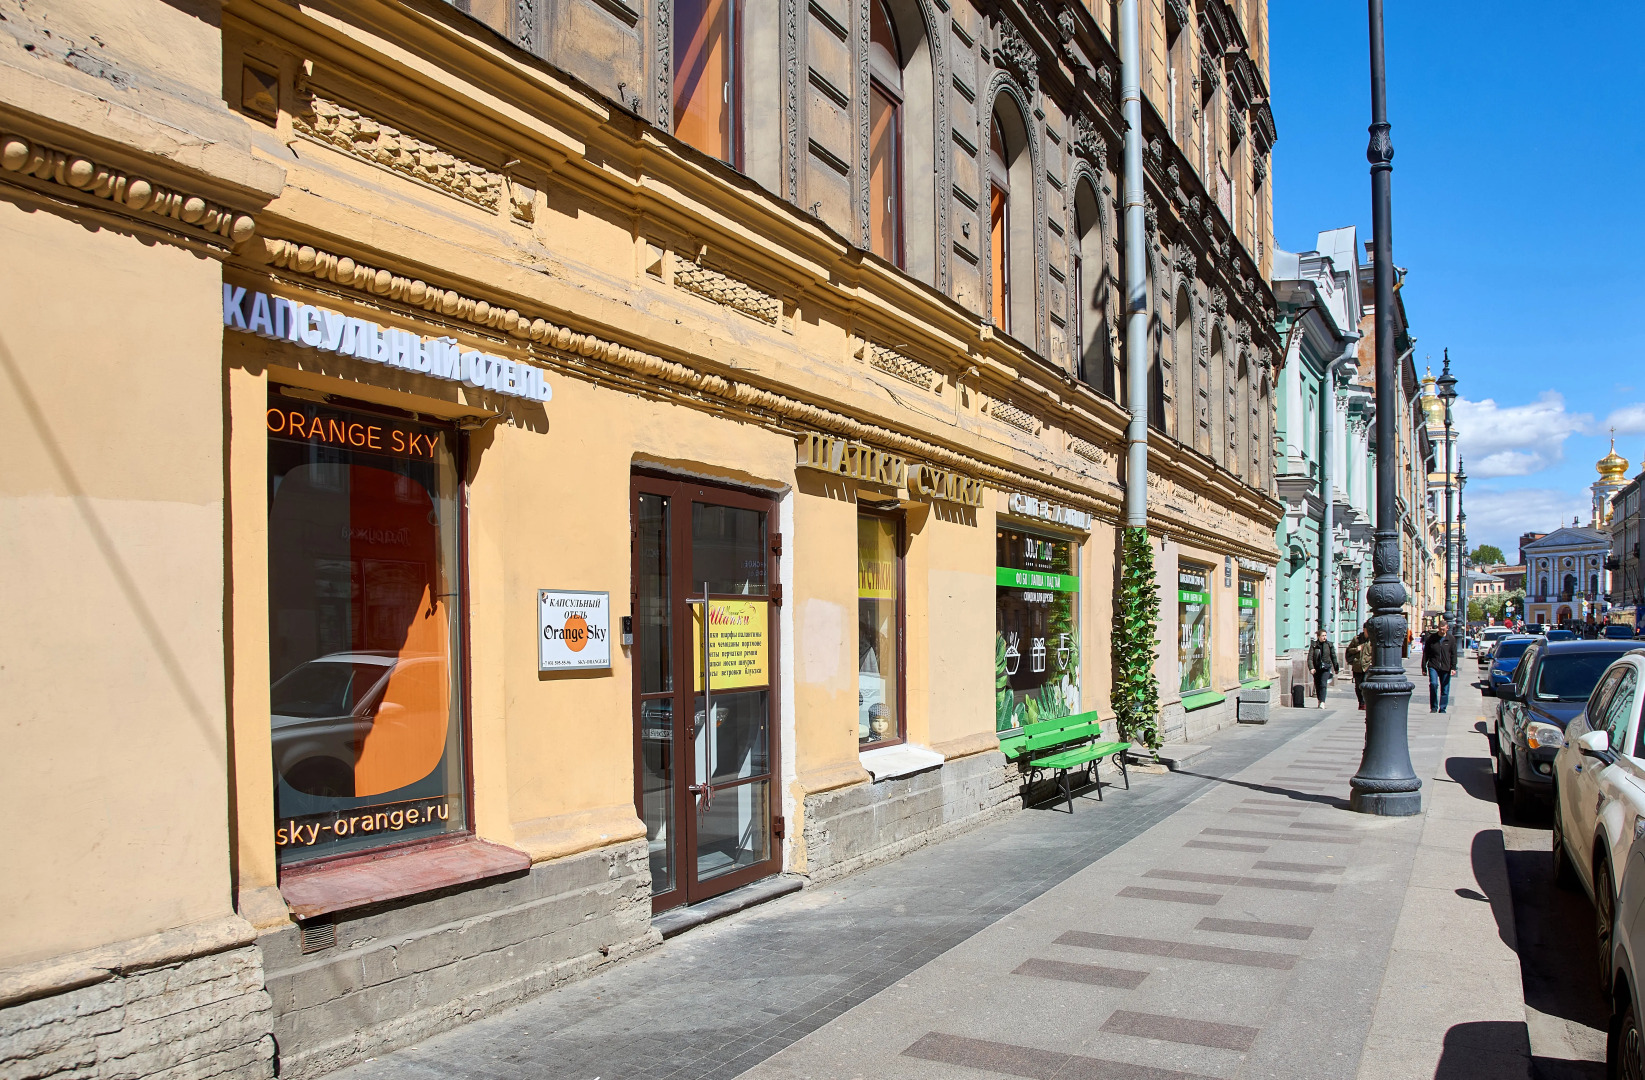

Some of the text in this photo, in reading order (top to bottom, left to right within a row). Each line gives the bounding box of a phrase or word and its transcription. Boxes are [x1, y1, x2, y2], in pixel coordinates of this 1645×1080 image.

[223, 283, 553, 402] КАПСУЛЬНЫЙ ОТЕЛЬ
[266, 408, 439, 458] ORANGE SKY
[799, 432, 985, 508] ШАПКИ СУМКИ
[549, 598, 601, 608] КАПСУЛЬНЫЙ
[564, 611, 588, 620] ОТЕЛЬ
[710, 605, 750, 626] Шапки
[543, 624, 606, 642] Orange Sky
[275, 803, 449, 846] sky-orange.ru
